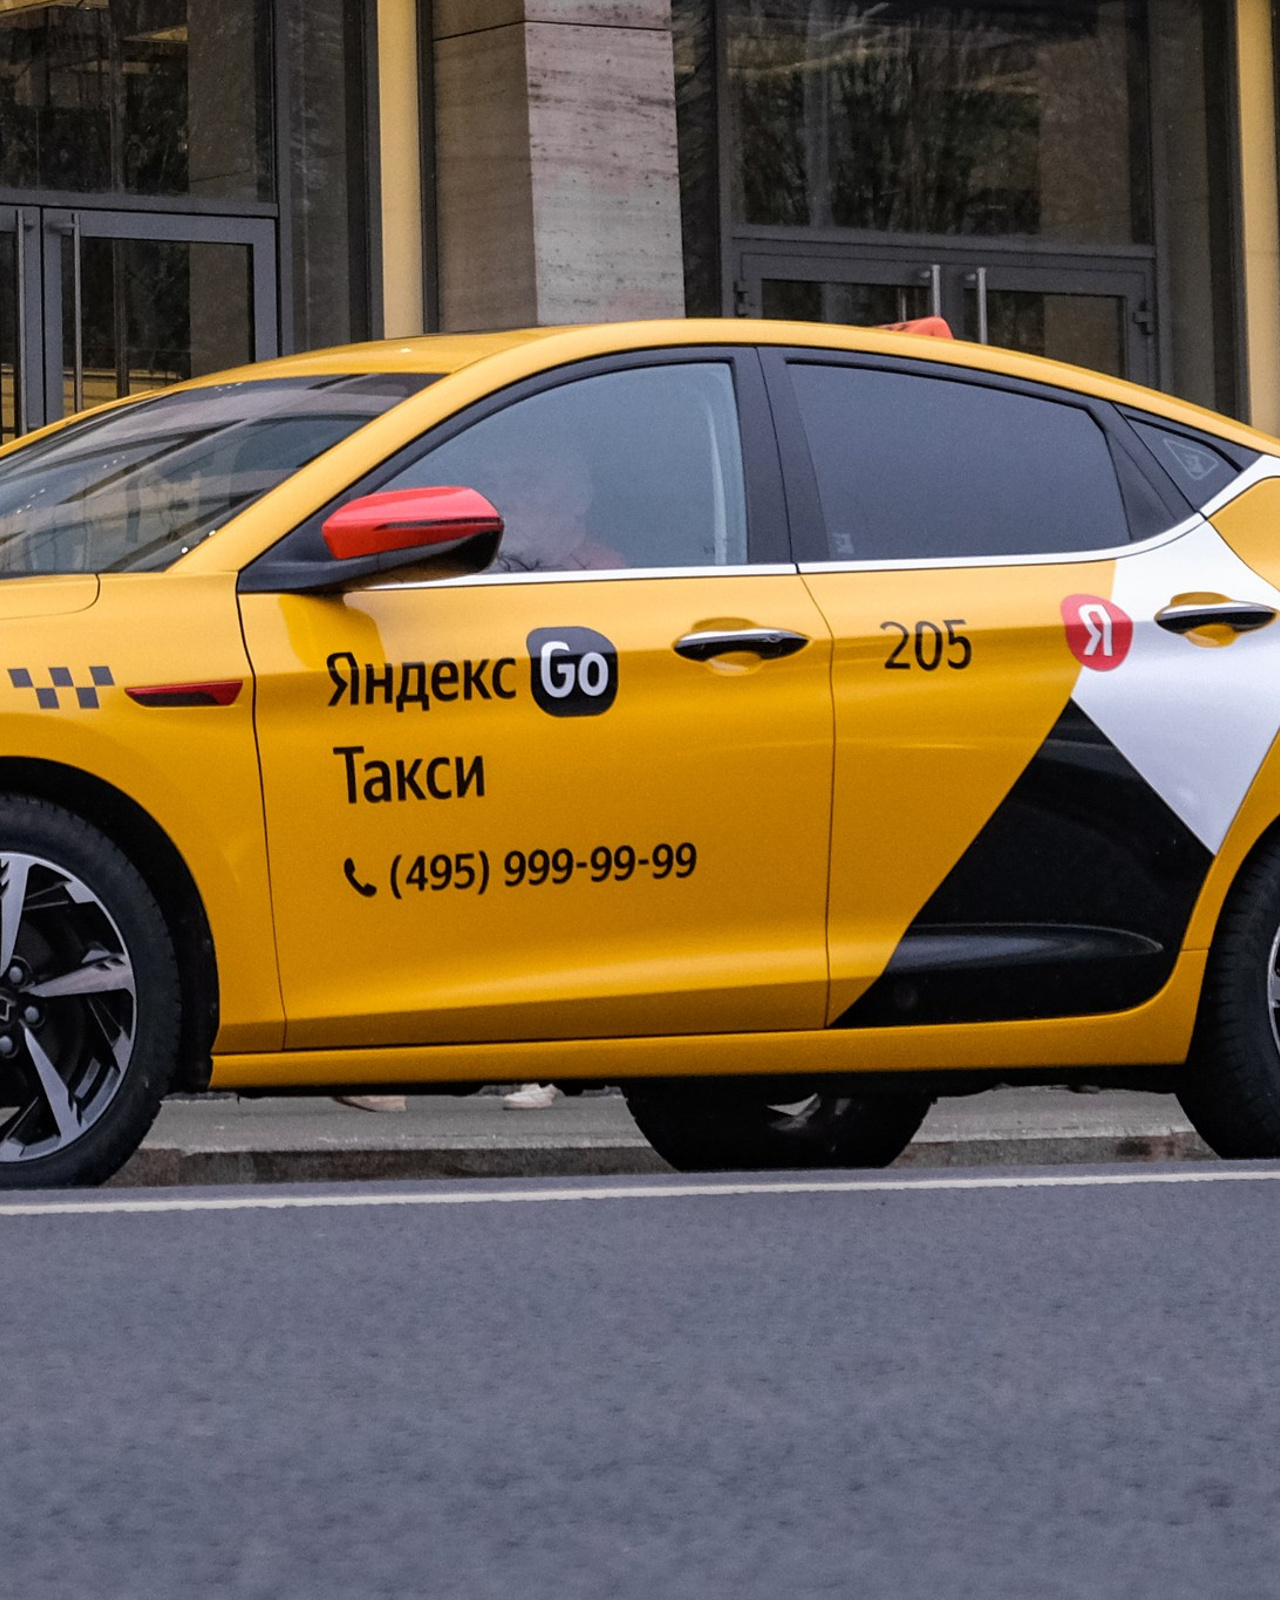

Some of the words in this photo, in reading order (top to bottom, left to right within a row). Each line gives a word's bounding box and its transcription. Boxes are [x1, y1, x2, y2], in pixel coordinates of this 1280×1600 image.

[880, 619, 972, 671] 205
[1078, 603, 1113, 656] Я
[326, 652, 517, 712] Яндекс
[540, 641, 609, 698] Go
[333, 746, 485, 804] Такси
[390, 850, 489, 899] (495)
[504, 842, 697, 886] 999-99-99
